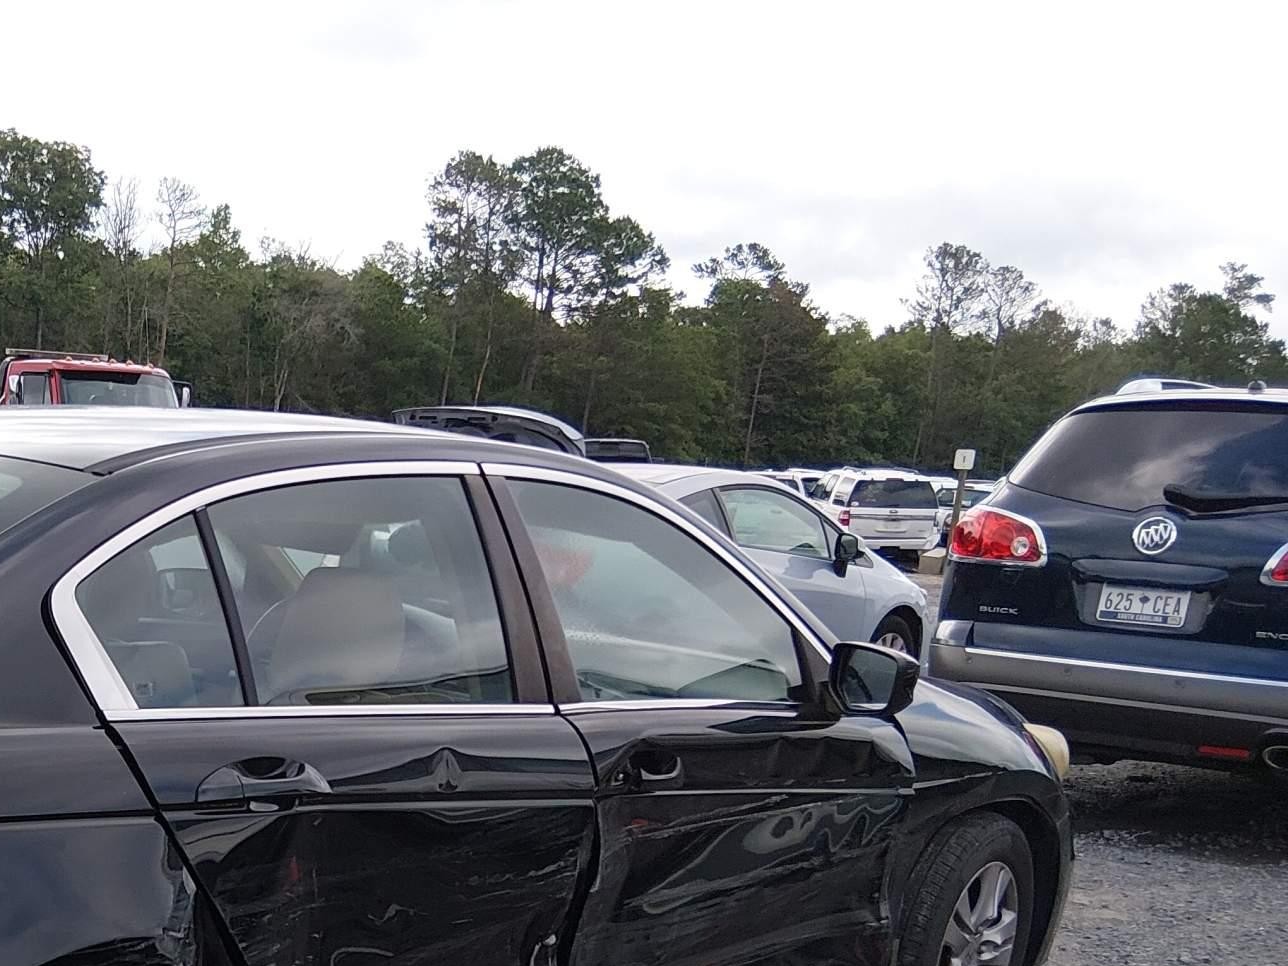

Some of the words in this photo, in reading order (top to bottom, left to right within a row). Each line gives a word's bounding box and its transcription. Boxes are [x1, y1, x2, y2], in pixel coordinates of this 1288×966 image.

[979, 605, 1018, 615] BUICK
[1105, 592, 1134, 611] 625
[1152, 595, 1182, 615] CEA
